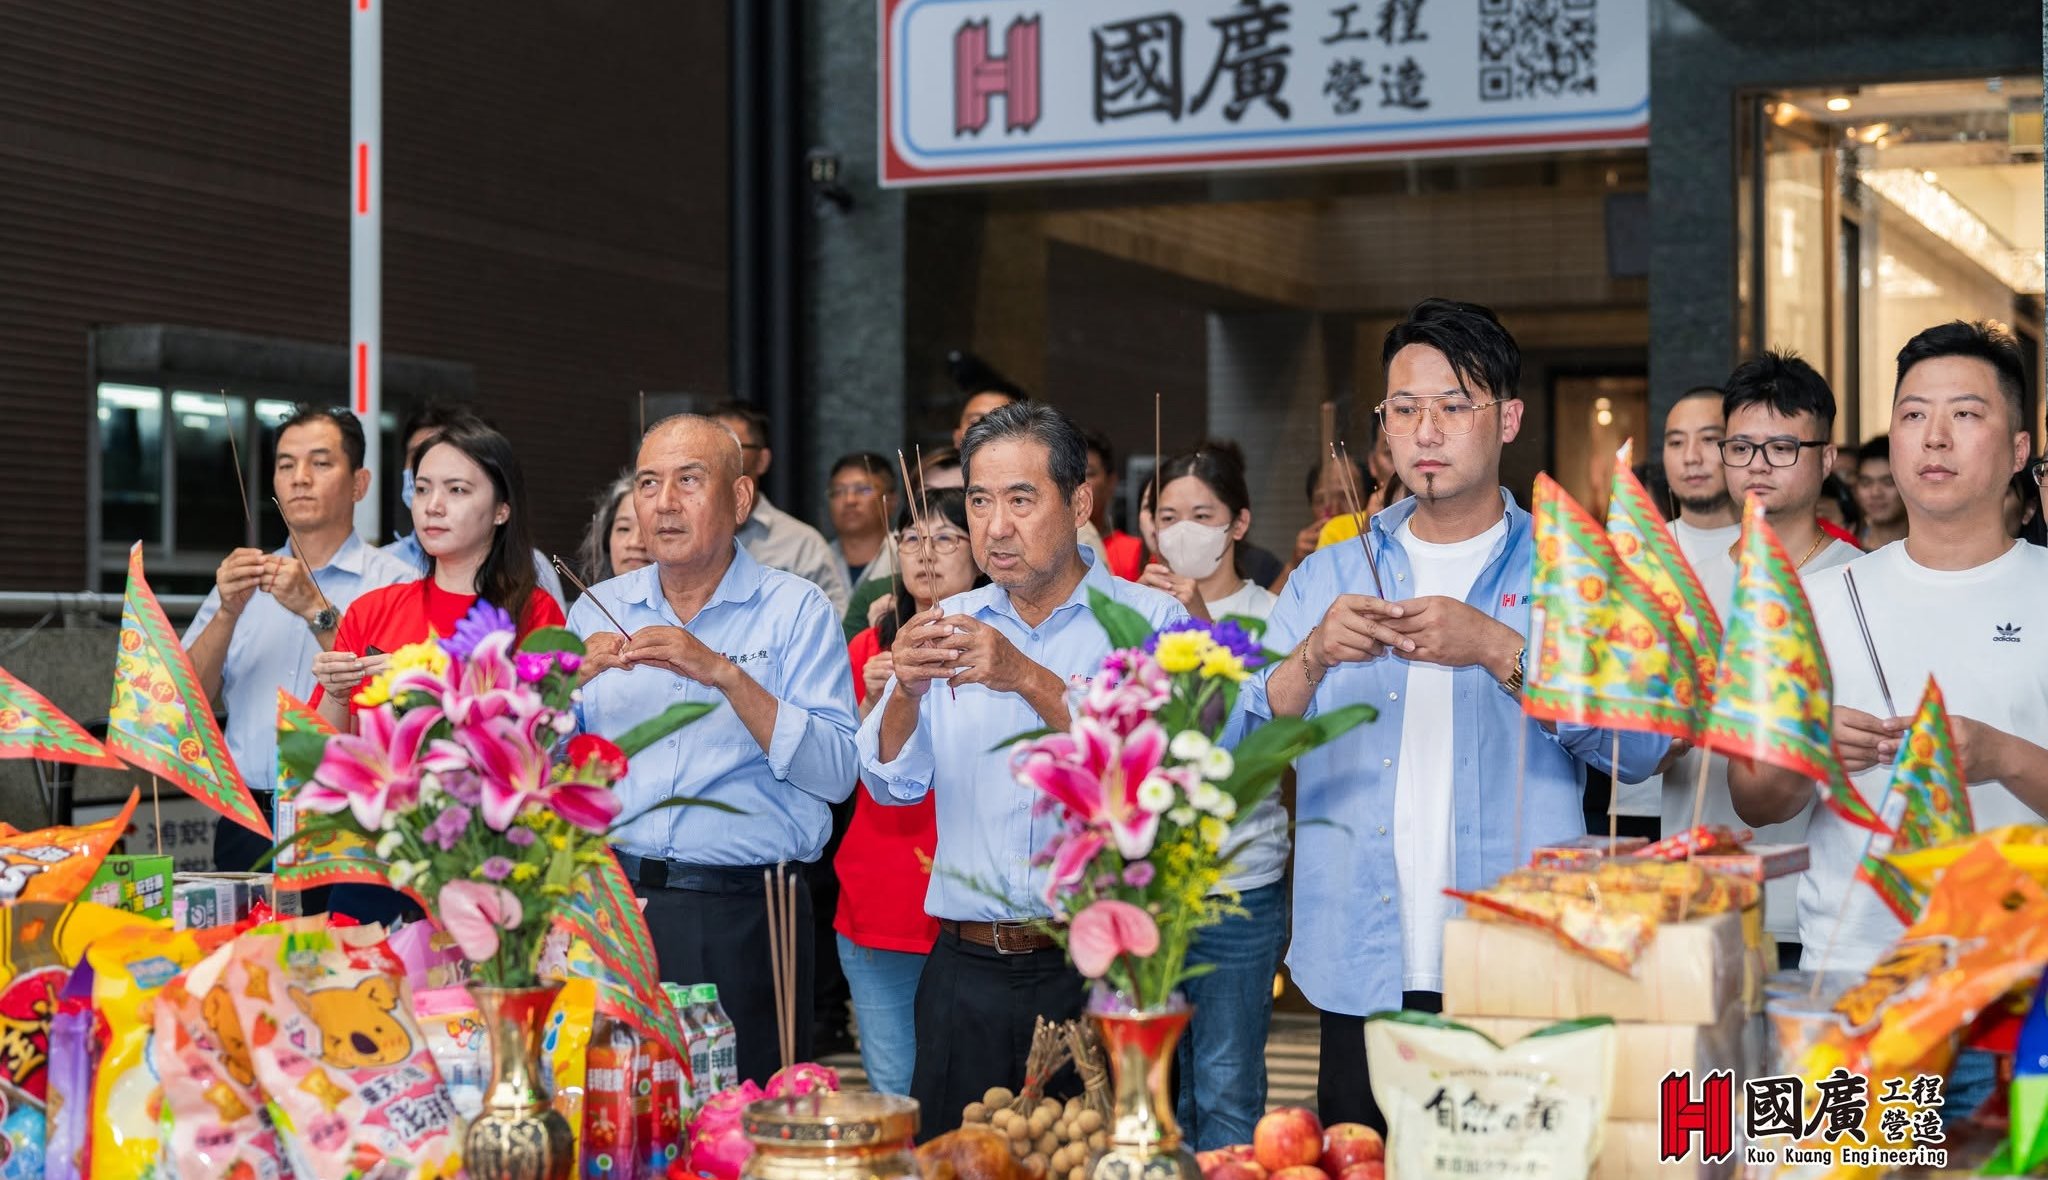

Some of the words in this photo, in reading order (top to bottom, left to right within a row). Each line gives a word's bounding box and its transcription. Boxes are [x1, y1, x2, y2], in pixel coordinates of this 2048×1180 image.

[1321, 0, 1428, 45] 工程
[1091, 0, 1292, 123] 國廣
[1322, 56, 1431, 115] 營造
[729, 650, 768, 664] 國廣工程
[1992, 635, 2021, 643] adidas
